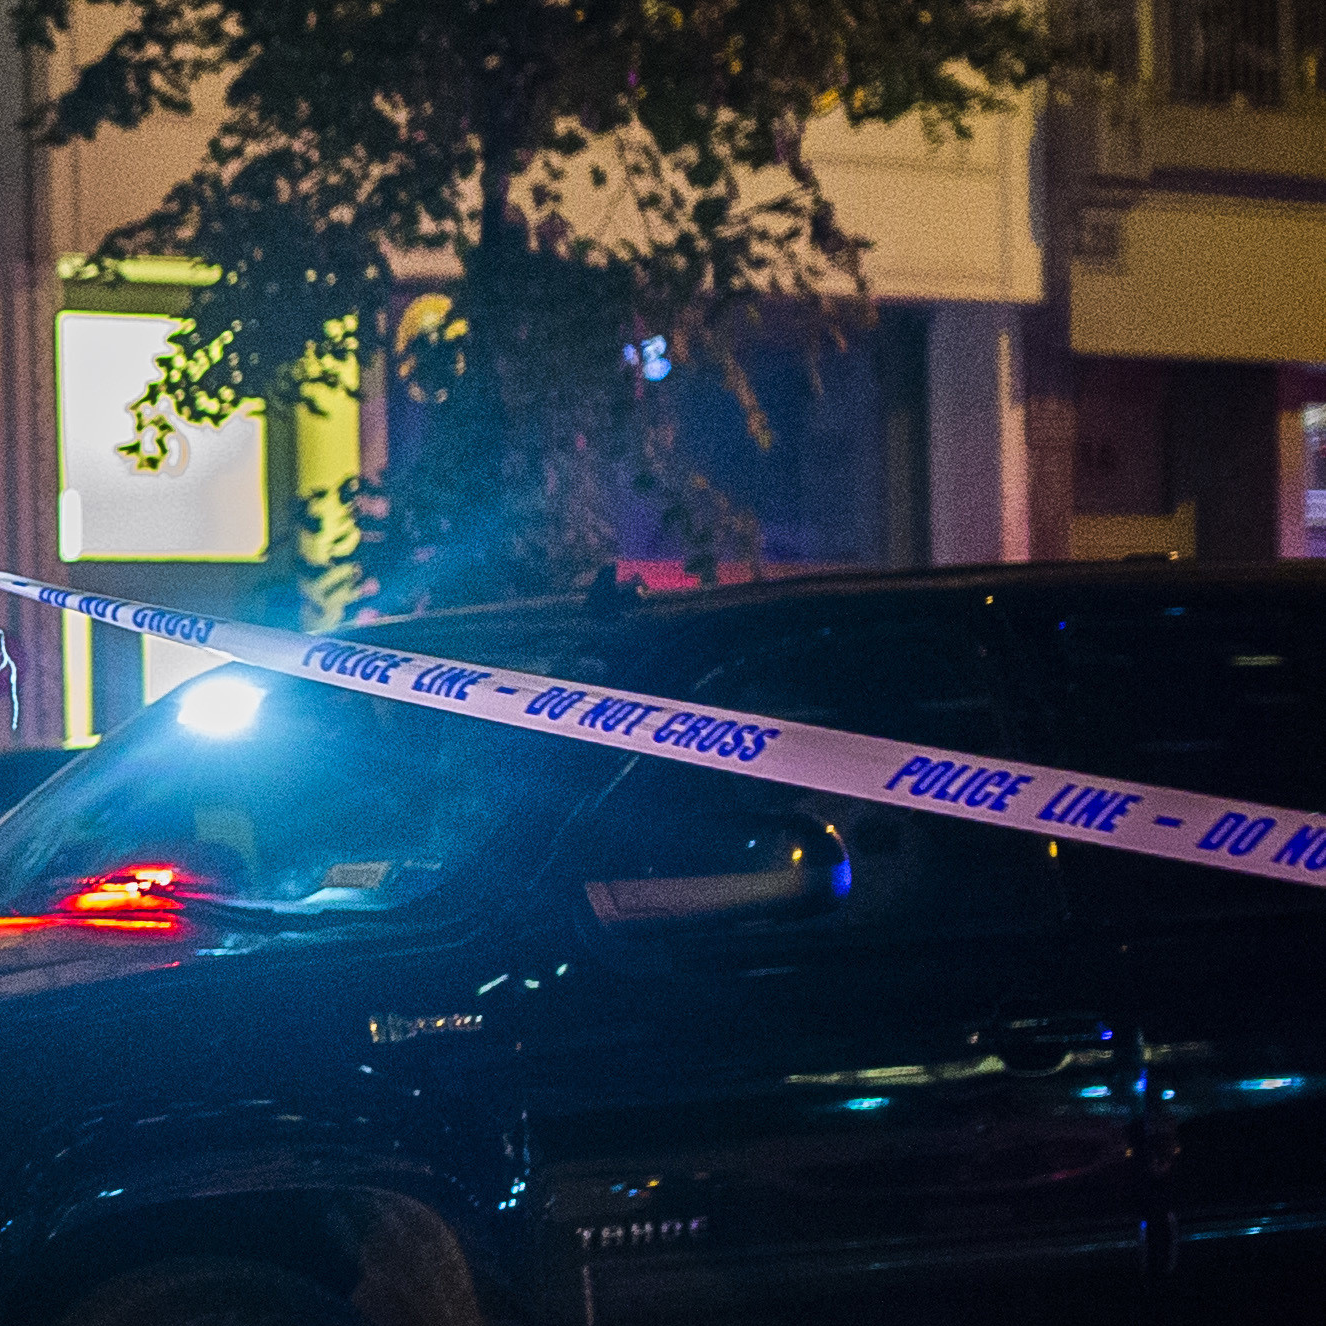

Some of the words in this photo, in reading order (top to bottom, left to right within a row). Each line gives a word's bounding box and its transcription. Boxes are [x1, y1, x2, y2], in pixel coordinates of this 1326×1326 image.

[301, 641, 412, 686] POLICE
[411, 662, 492, 701] LINE
[524, 685, 588, 722] DO
[578, 696, 662, 737] NOT
[652, 711, 783, 763] CROSS
[885, 755, 1035, 813] POLICE
[1036, 783, 1146, 834] LINE
[1196, 810, 1277, 857] DO
